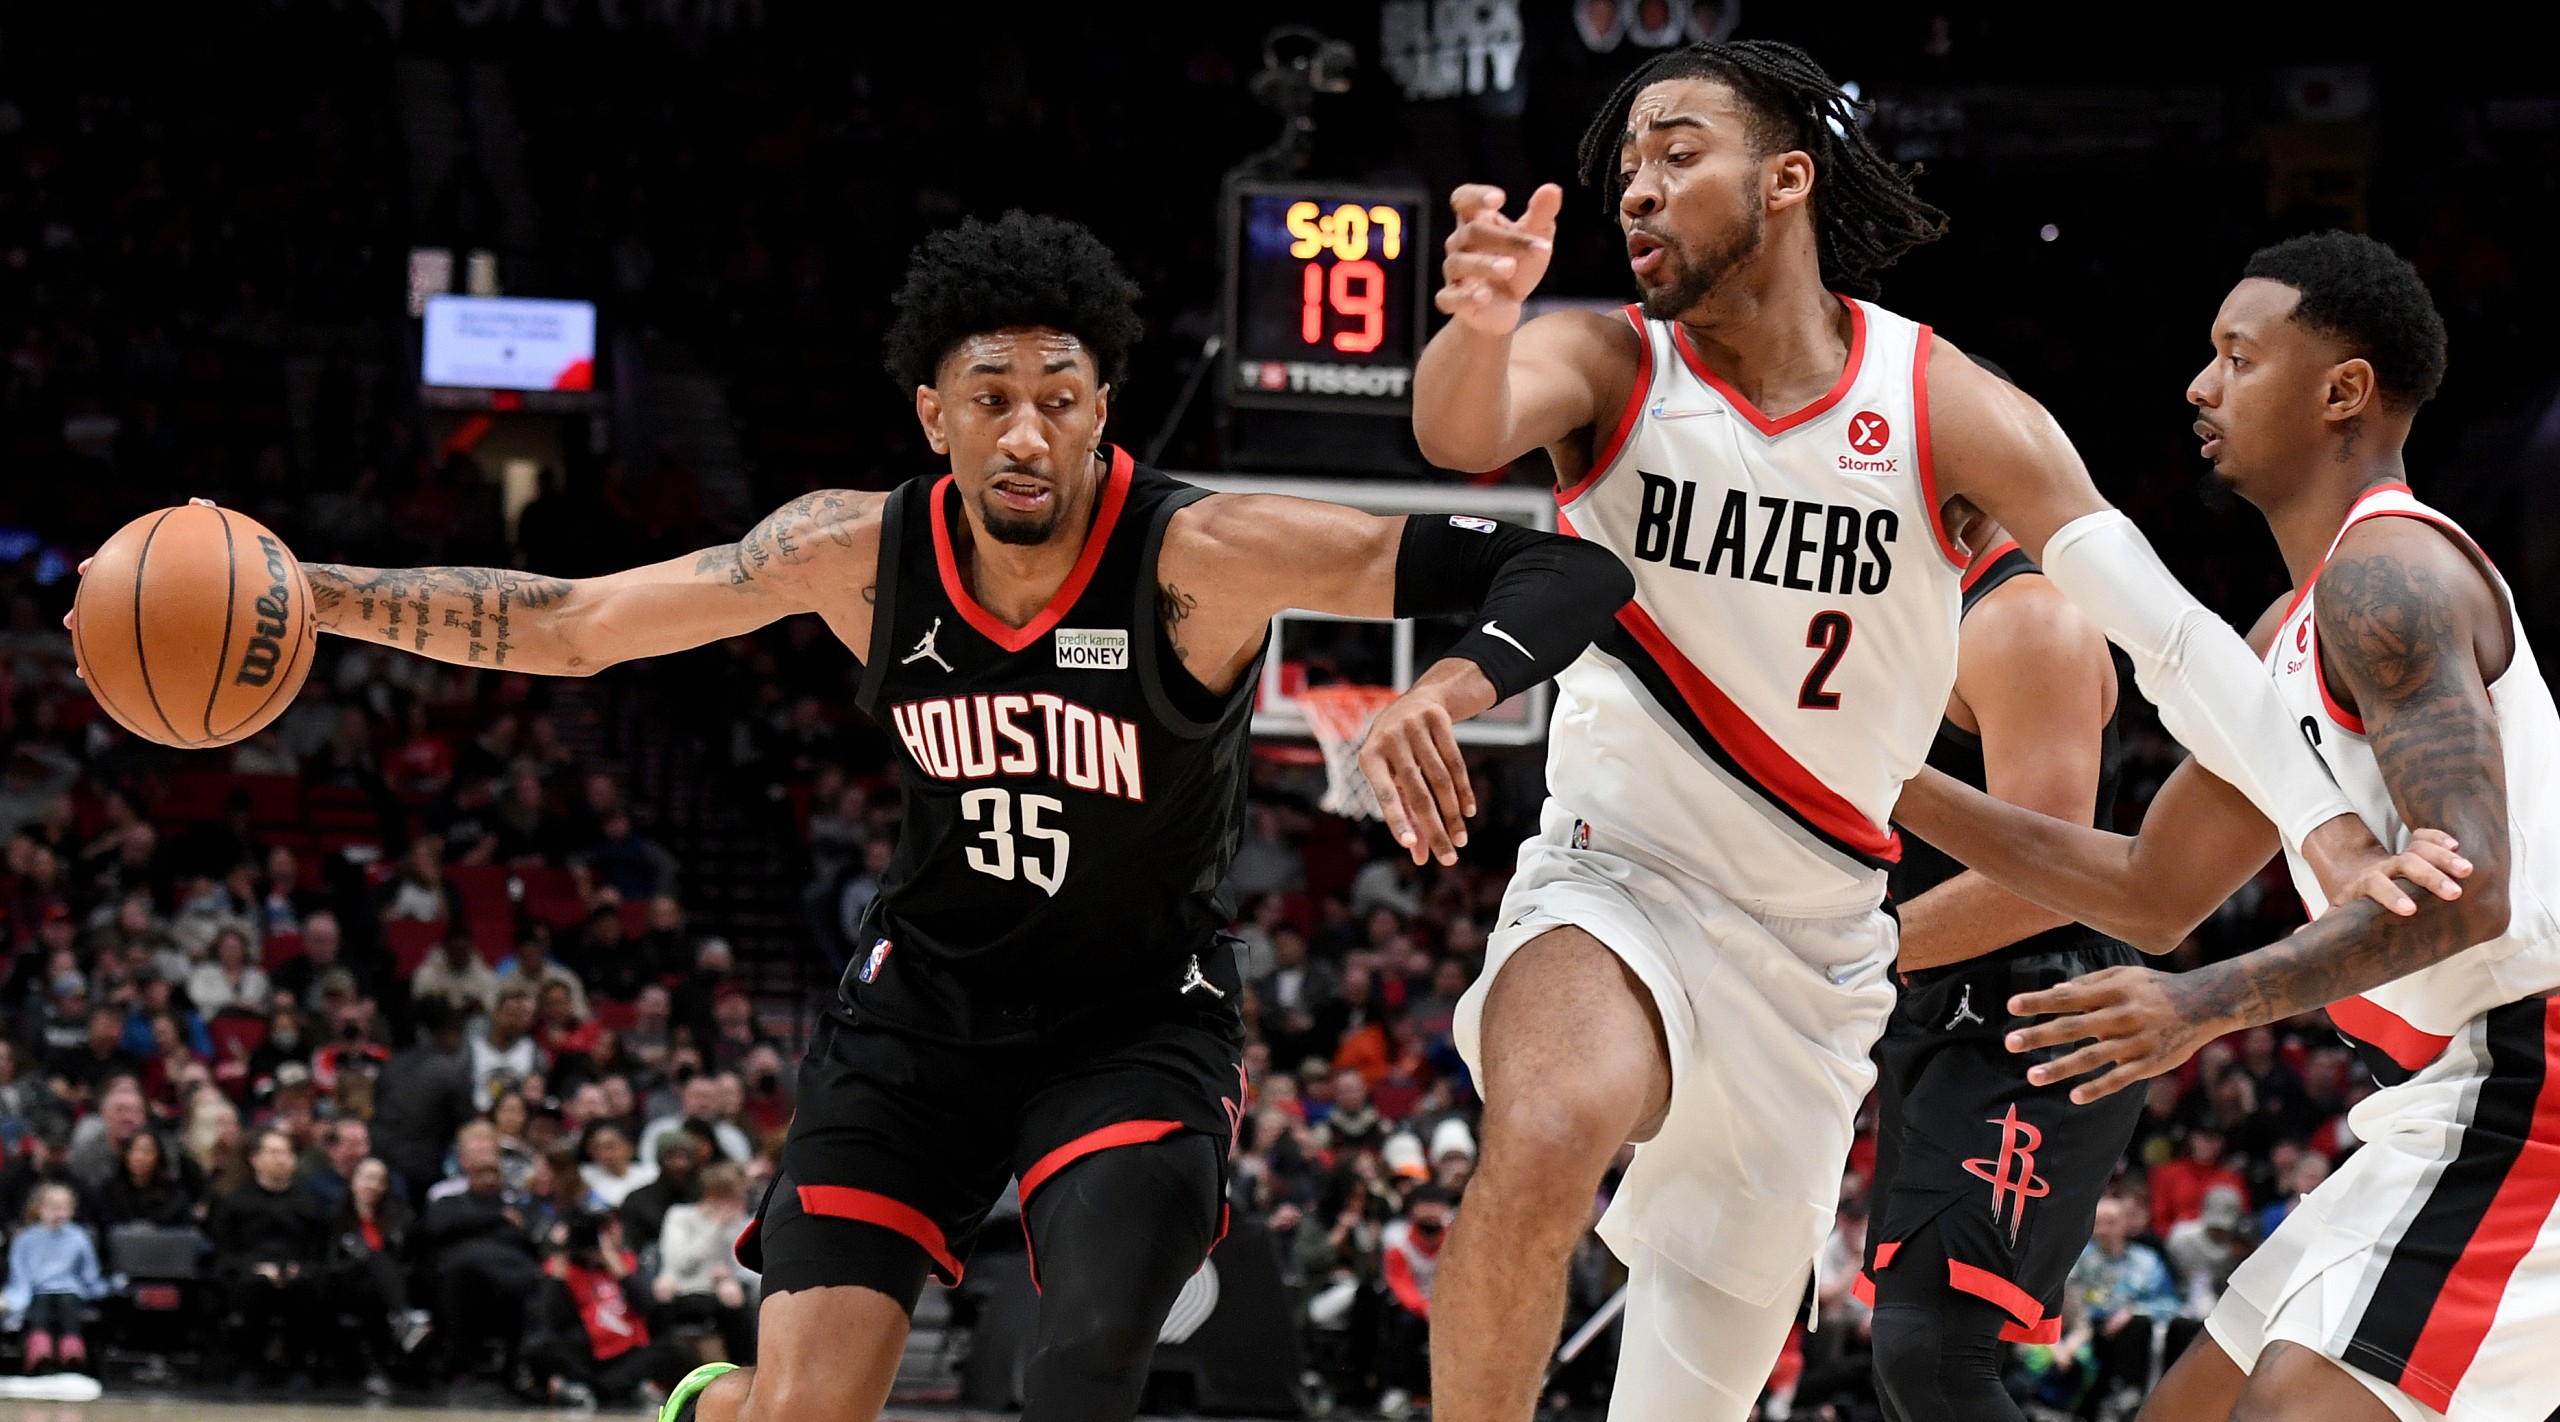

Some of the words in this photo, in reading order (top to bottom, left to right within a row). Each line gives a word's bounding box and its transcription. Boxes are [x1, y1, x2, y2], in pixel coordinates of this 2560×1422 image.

[1287, 201, 1401, 261] 5:07
[1302, 260, 1384, 352] 19
[1287, 362, 1411, 396] TISSOT
[1838, 455, 1899, 472] StormX
[1634, 470, 1899, 596] BLAZERS
[233, 534, 289, 688] Wilson
[1058, 633, 1087, 646] credit
[1090, 634, 1125, 646] karma
[1059, 647, 1124, 665] MONEY
[1797, 610, 1853, 711] 2
[891, 692, 1144, 802] HOUSTON
[961, 788, 1070, 897] 35
